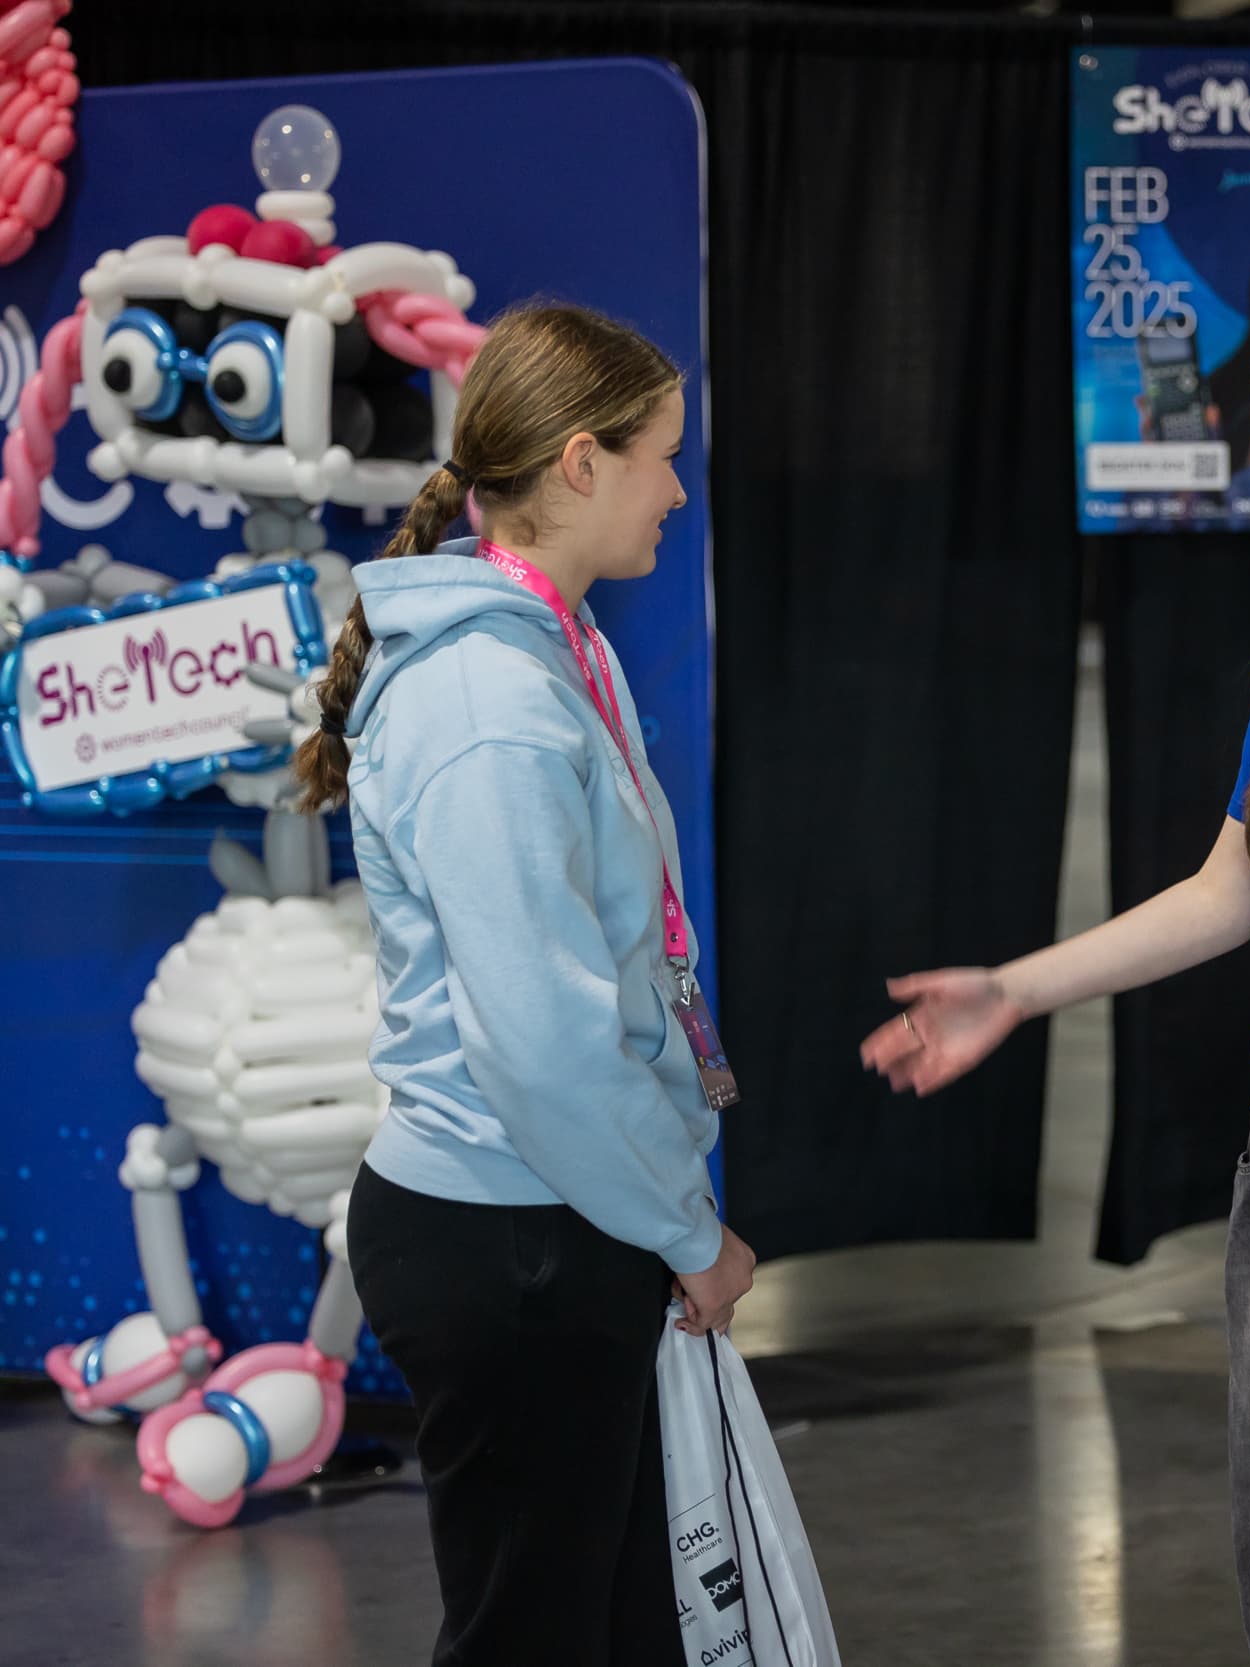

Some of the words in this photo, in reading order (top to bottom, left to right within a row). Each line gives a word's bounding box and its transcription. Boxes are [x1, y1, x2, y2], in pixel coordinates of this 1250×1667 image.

[1084, 166, 1169, 224] FEB
[1085, 280, 1198, 339] 2025
[37, 620, 281, 729] SheTech
[682, 1537, 724, 1564] Healthcare
